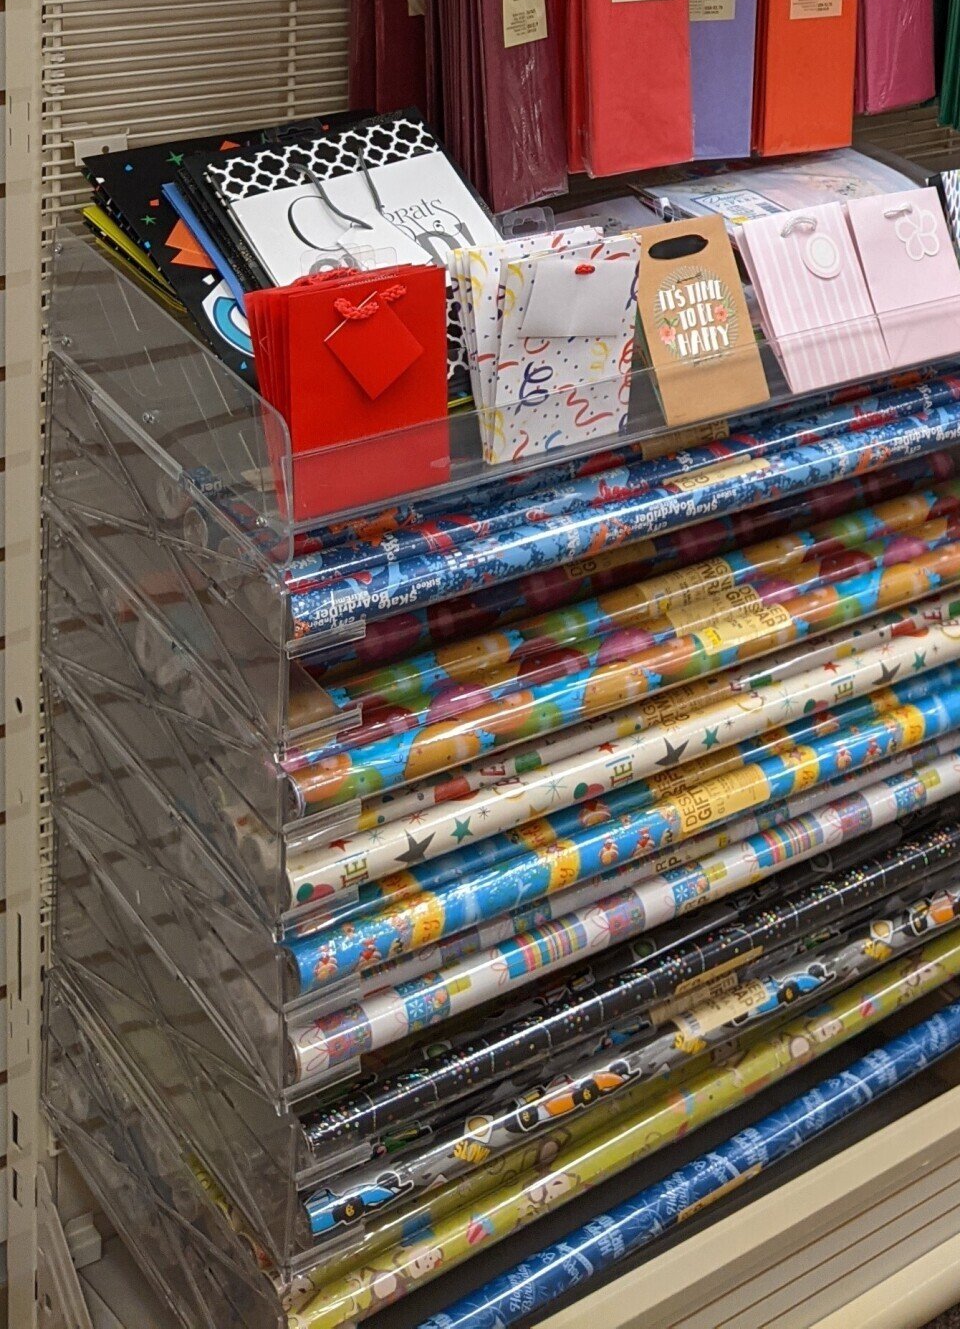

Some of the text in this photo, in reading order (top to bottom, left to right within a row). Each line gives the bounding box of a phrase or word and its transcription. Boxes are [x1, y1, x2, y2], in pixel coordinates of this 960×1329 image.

[658, 279, 724, 312] IT'S TIME
[679, 303, 715, 332] TO BE
[677, 324, 730, 357] HAPPY
